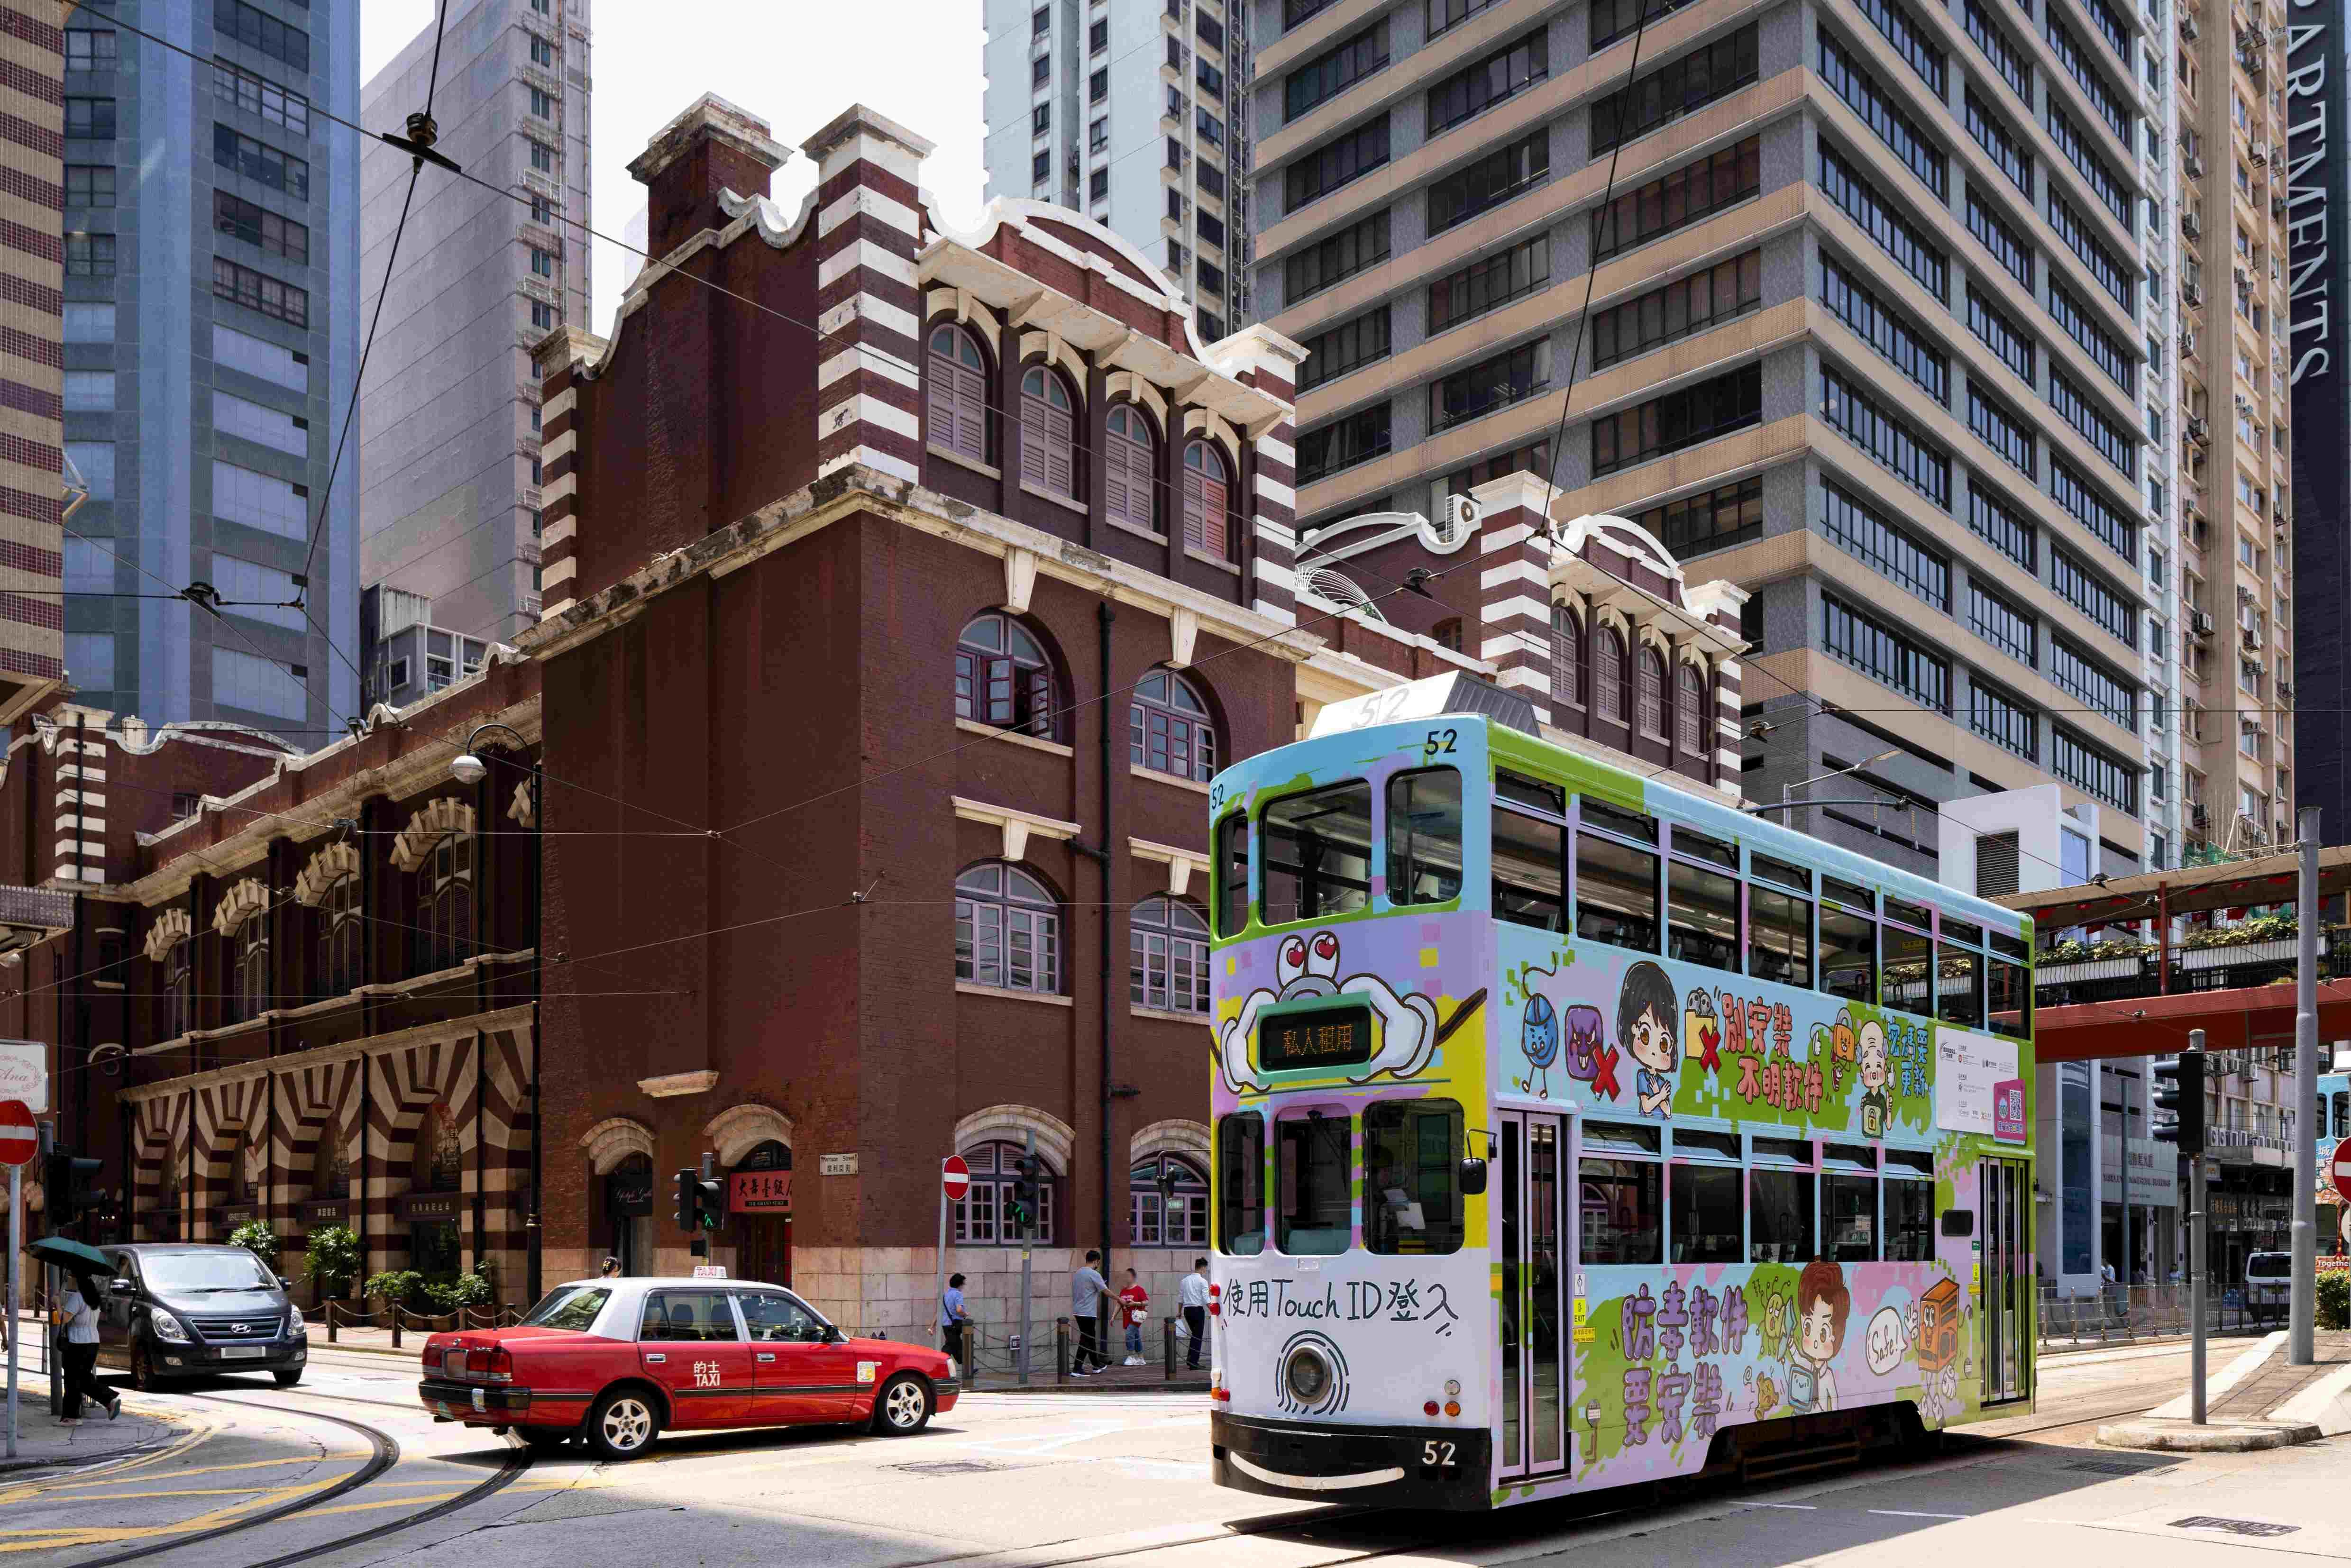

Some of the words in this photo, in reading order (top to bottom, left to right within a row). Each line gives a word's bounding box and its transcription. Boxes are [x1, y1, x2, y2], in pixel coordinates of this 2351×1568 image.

[2287, 0, 2329, 387] ARTMENTS
[1425, 729, 1457, 755] 52
[1211, 784, 1224, 810] 52
[1283, 1024, 1352, 1057] 私人租用
[1721, 993, 1793, 1057] 別安裝
[1887, 1016, 1929, 1065] 密碼要
[1737, 1056, 1824, 1114] 不明軟件
[1901, 1061, 1927, 1099] 更新
[827, 1164, 851, 1173] 摩利臣街
[696, 1267, 717, 1276] TAXI
[1622, 1281, 1748, 1361] 防毒軟件
[1872, 1328, 1900, 1366] Safe!
[694, 1361, 720, 1373] 的士
[694, 1373, 720, 1386] TAXI
[1622, 1361, 1722, 1446] 要安裝
[1422, 1441, 1455, 1466] 52
